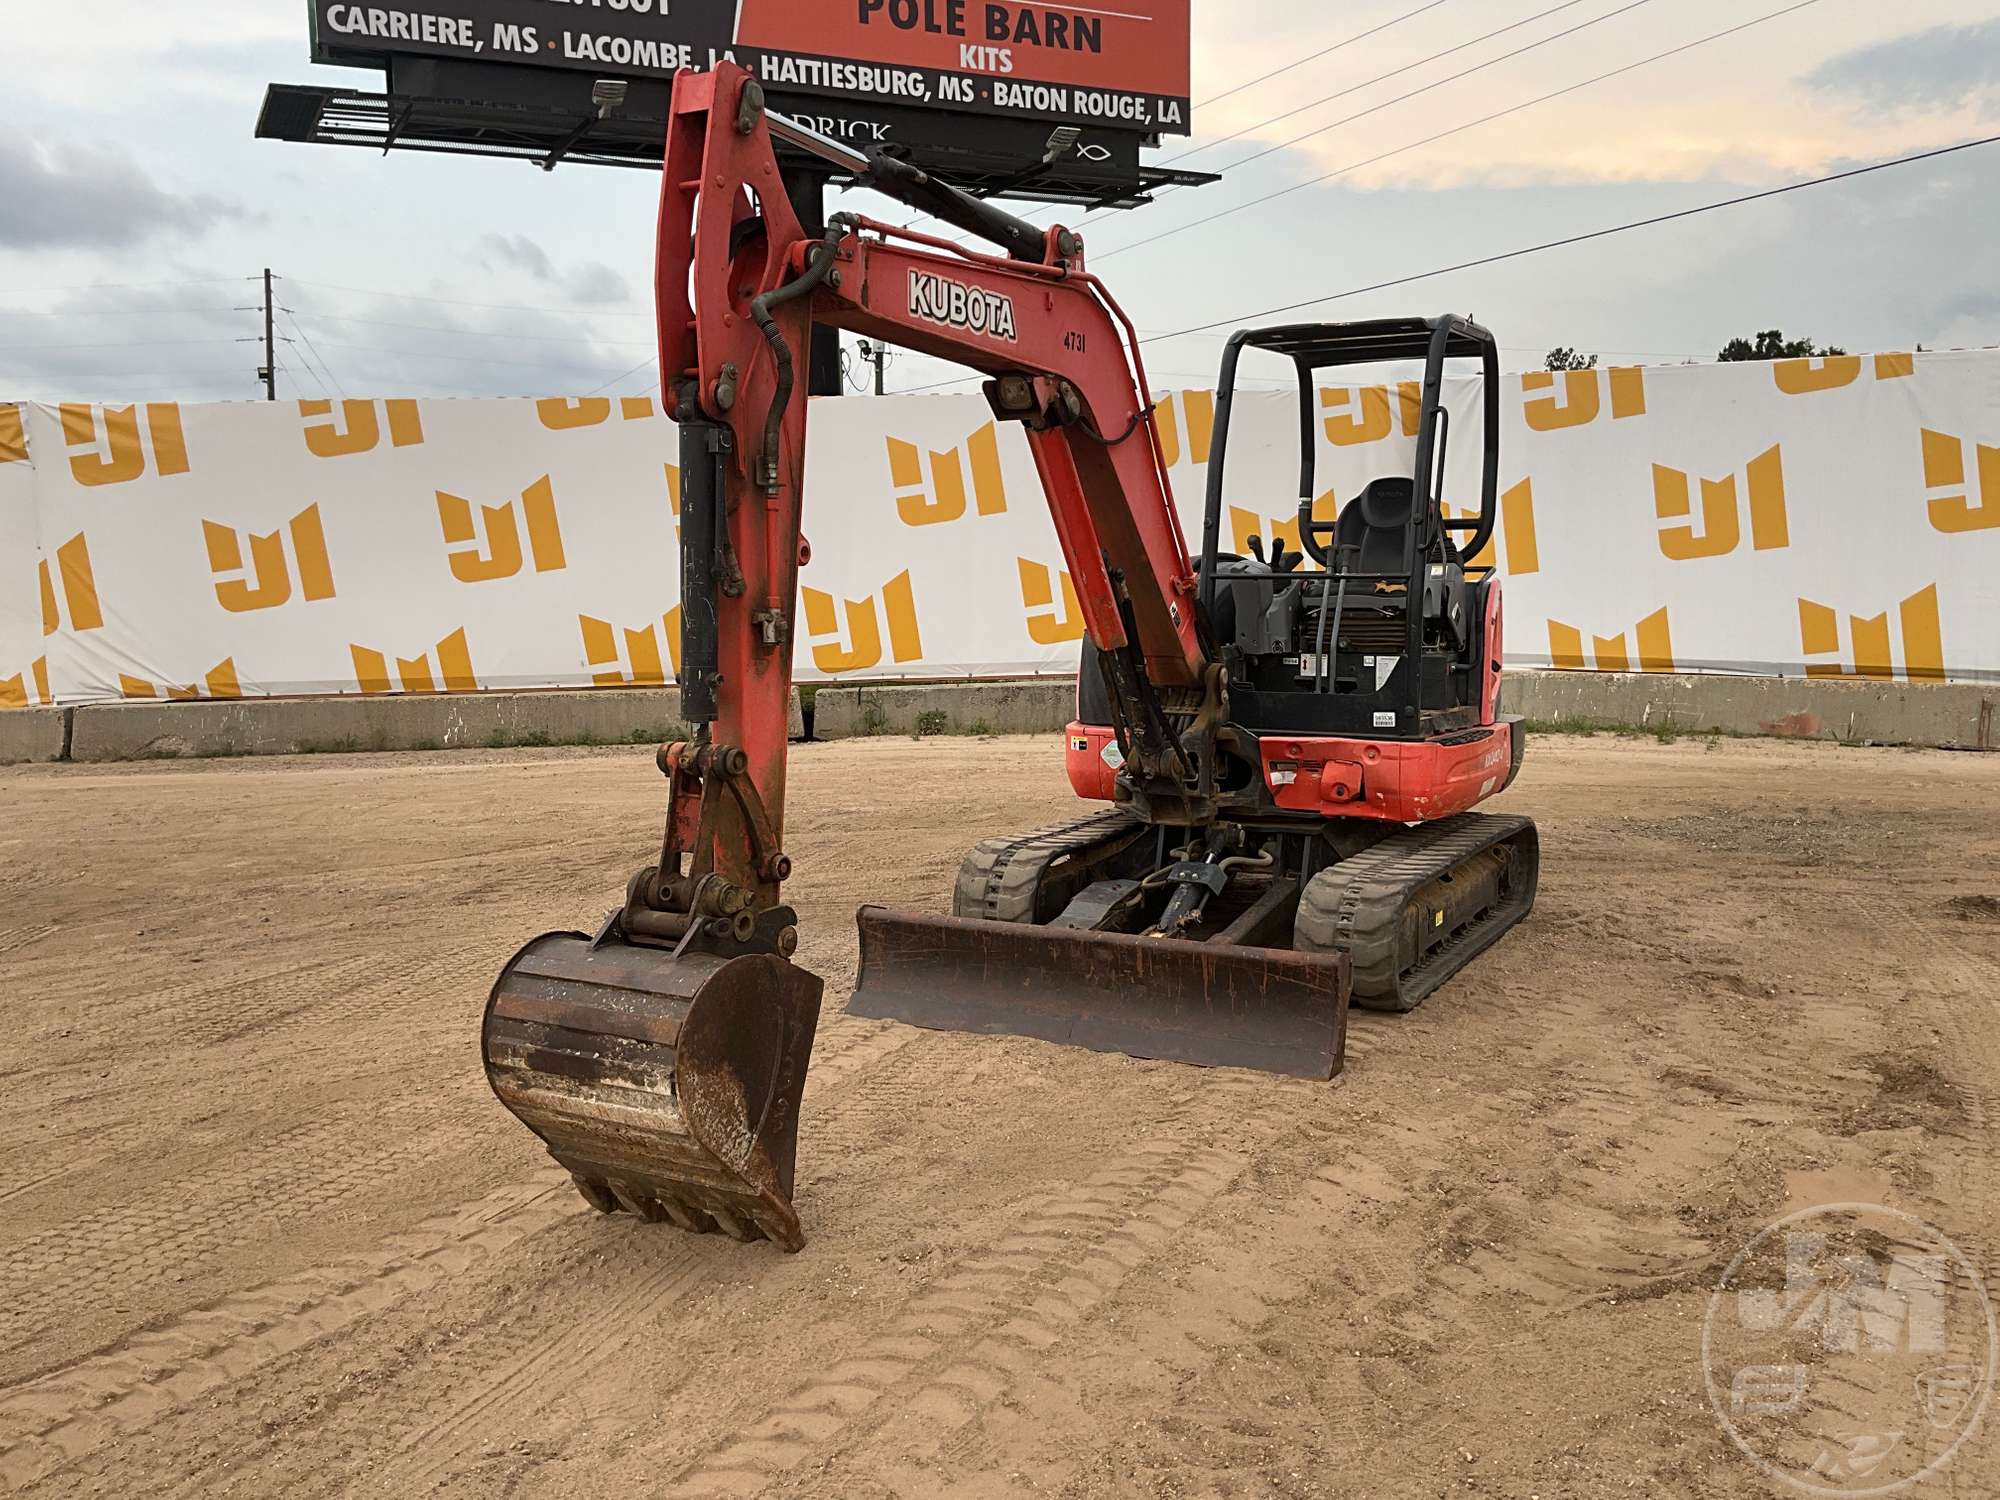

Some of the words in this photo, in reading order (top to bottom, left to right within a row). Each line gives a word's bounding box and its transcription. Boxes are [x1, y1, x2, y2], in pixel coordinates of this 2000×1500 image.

[858, 0, 966, 37] POLE
[985, 4, 1102, 54] BARN
[326, 4, 484, 53] CARRIERE,
[493, 23, 540, 54] MS
[761, 55, 932, 102] HATTIESBURG,
[938, 76, 975, 103] MS
[993, 82, 1067, 112] BATON
[1073, 91, 1151, 125] ROUGE,
[1157, 100, 1181, 124] LA
[959, 43, 1014, 73] KITS
[777, 113, 892, 141] DRICK
[909, 270, 1017, 340] KUBOTA
[1063, 331, 1086, 354] 4731
